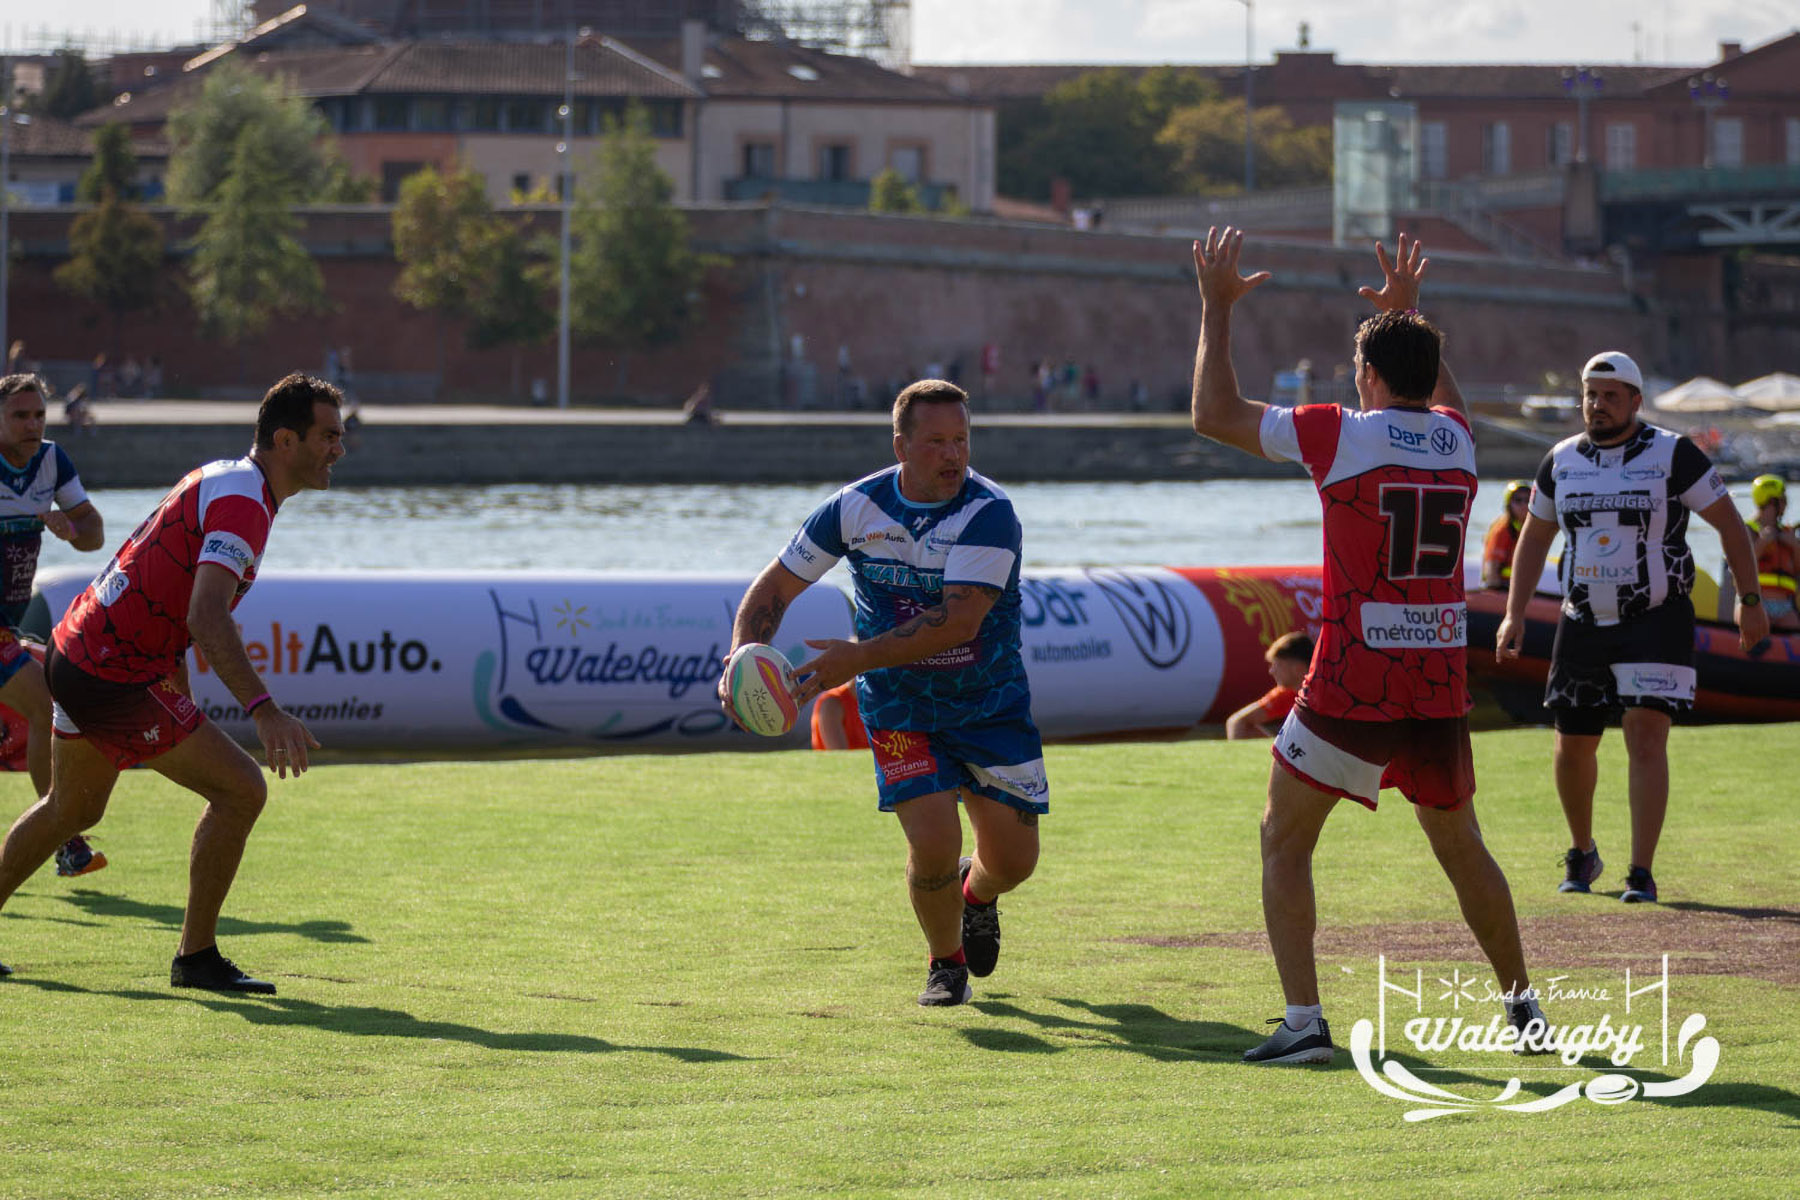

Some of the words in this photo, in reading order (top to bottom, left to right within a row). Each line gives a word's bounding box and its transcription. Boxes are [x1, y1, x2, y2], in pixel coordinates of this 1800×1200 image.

[1558, 493, 1662, 513] WATERUGBY
[1380, 484, 1470, 580] 15
[1575, 565, 1634, 578] artlux
[1031, 636, 1112, 663] automobiles
[526, 642, 724, 699] WateRugb
